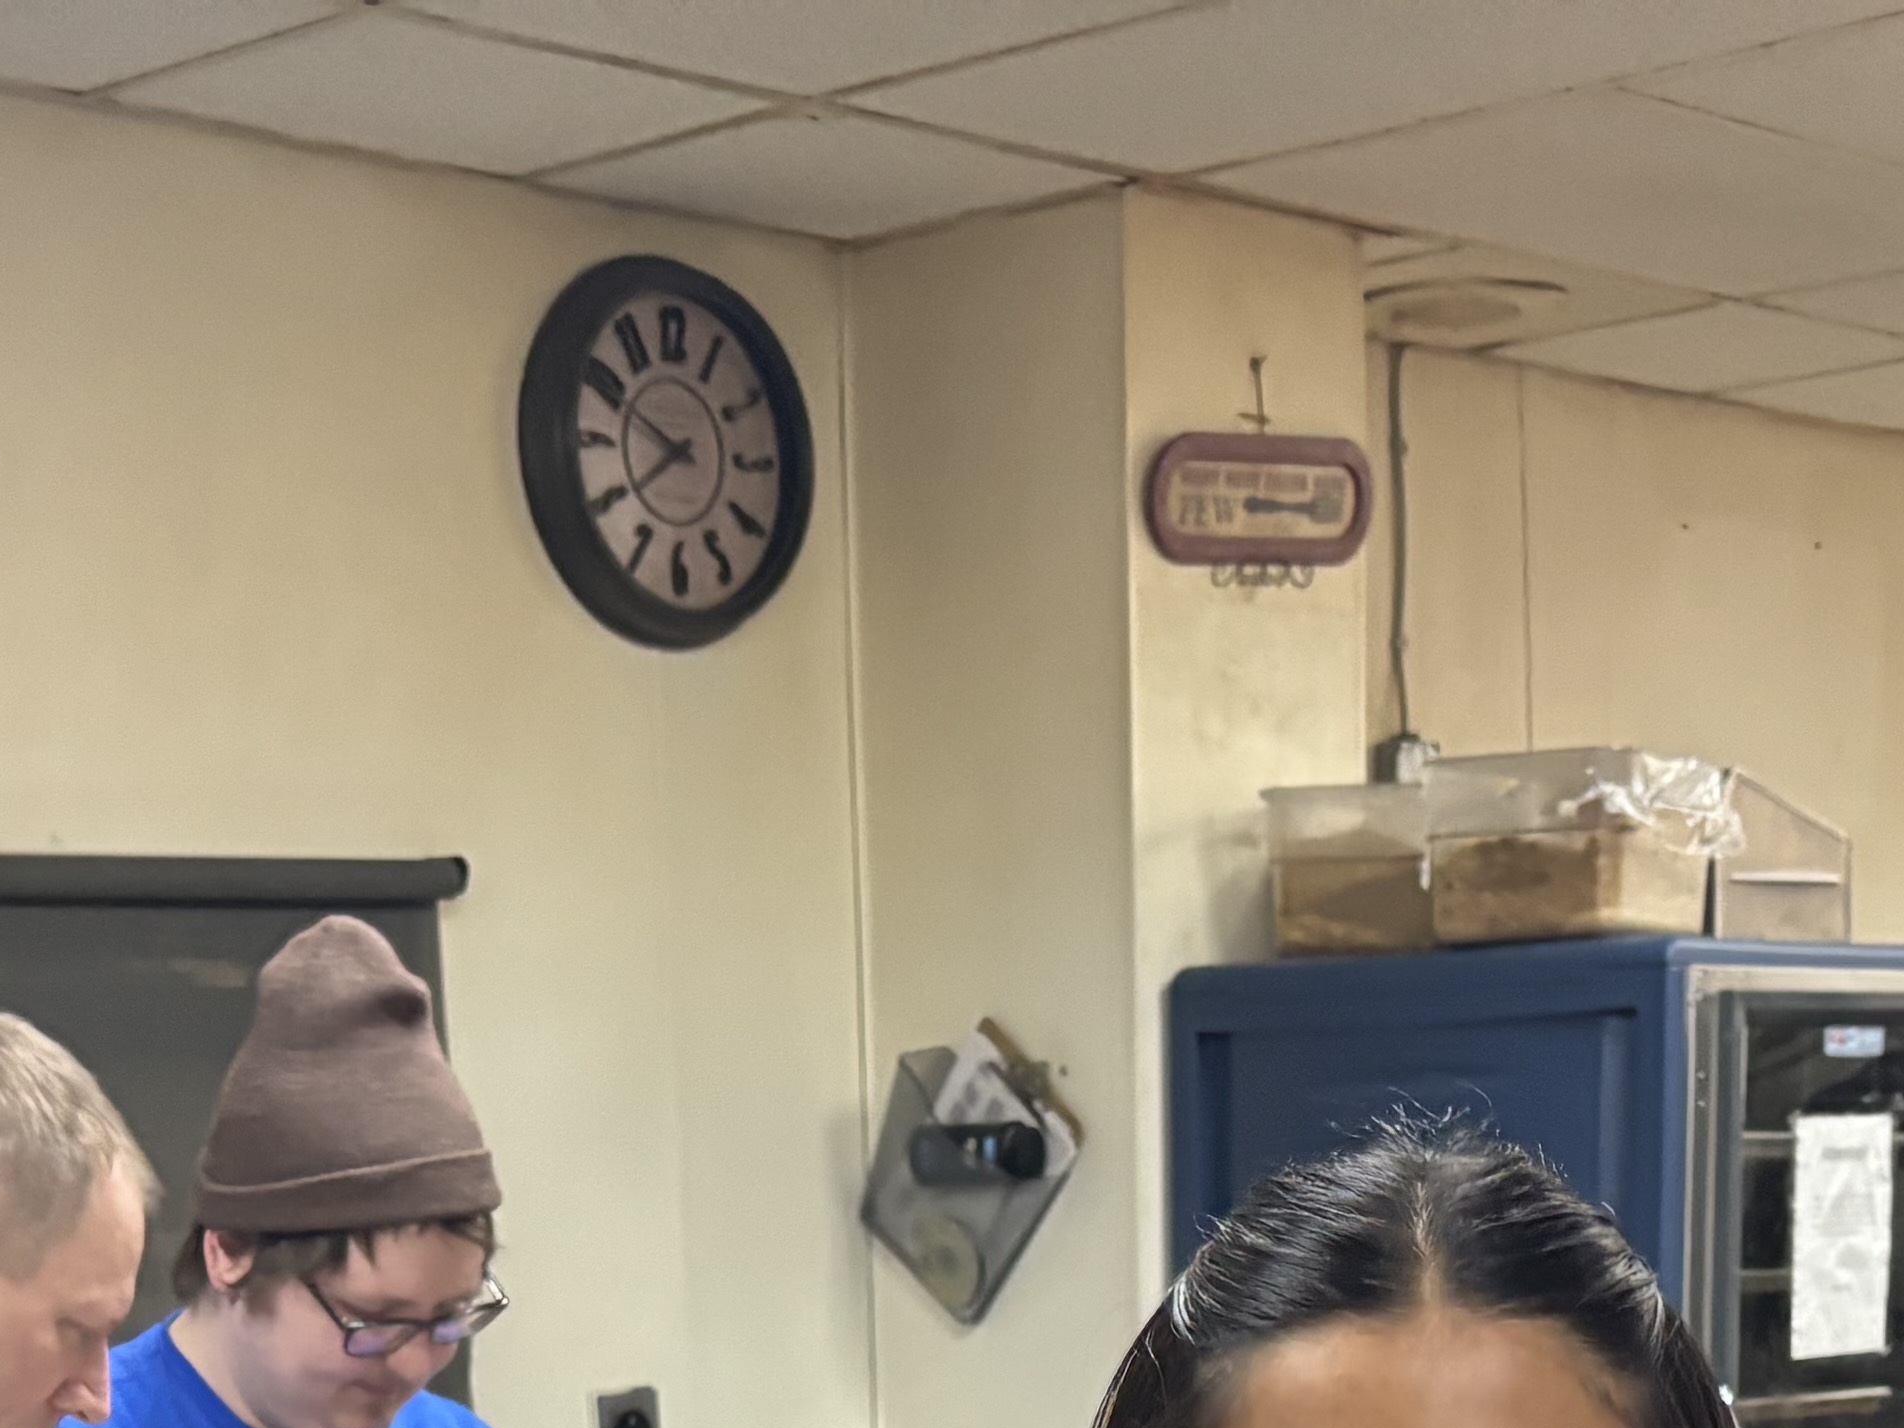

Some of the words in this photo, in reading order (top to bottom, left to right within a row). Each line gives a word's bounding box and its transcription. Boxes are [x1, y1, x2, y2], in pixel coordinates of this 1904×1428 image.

[659, 305, 687, 363] 12
[698, 334, 725, 384] 1
[627, 522, 653, 575] 7
[671, 541, 689, 597] 6
[703, 529, 733, 586] 5
